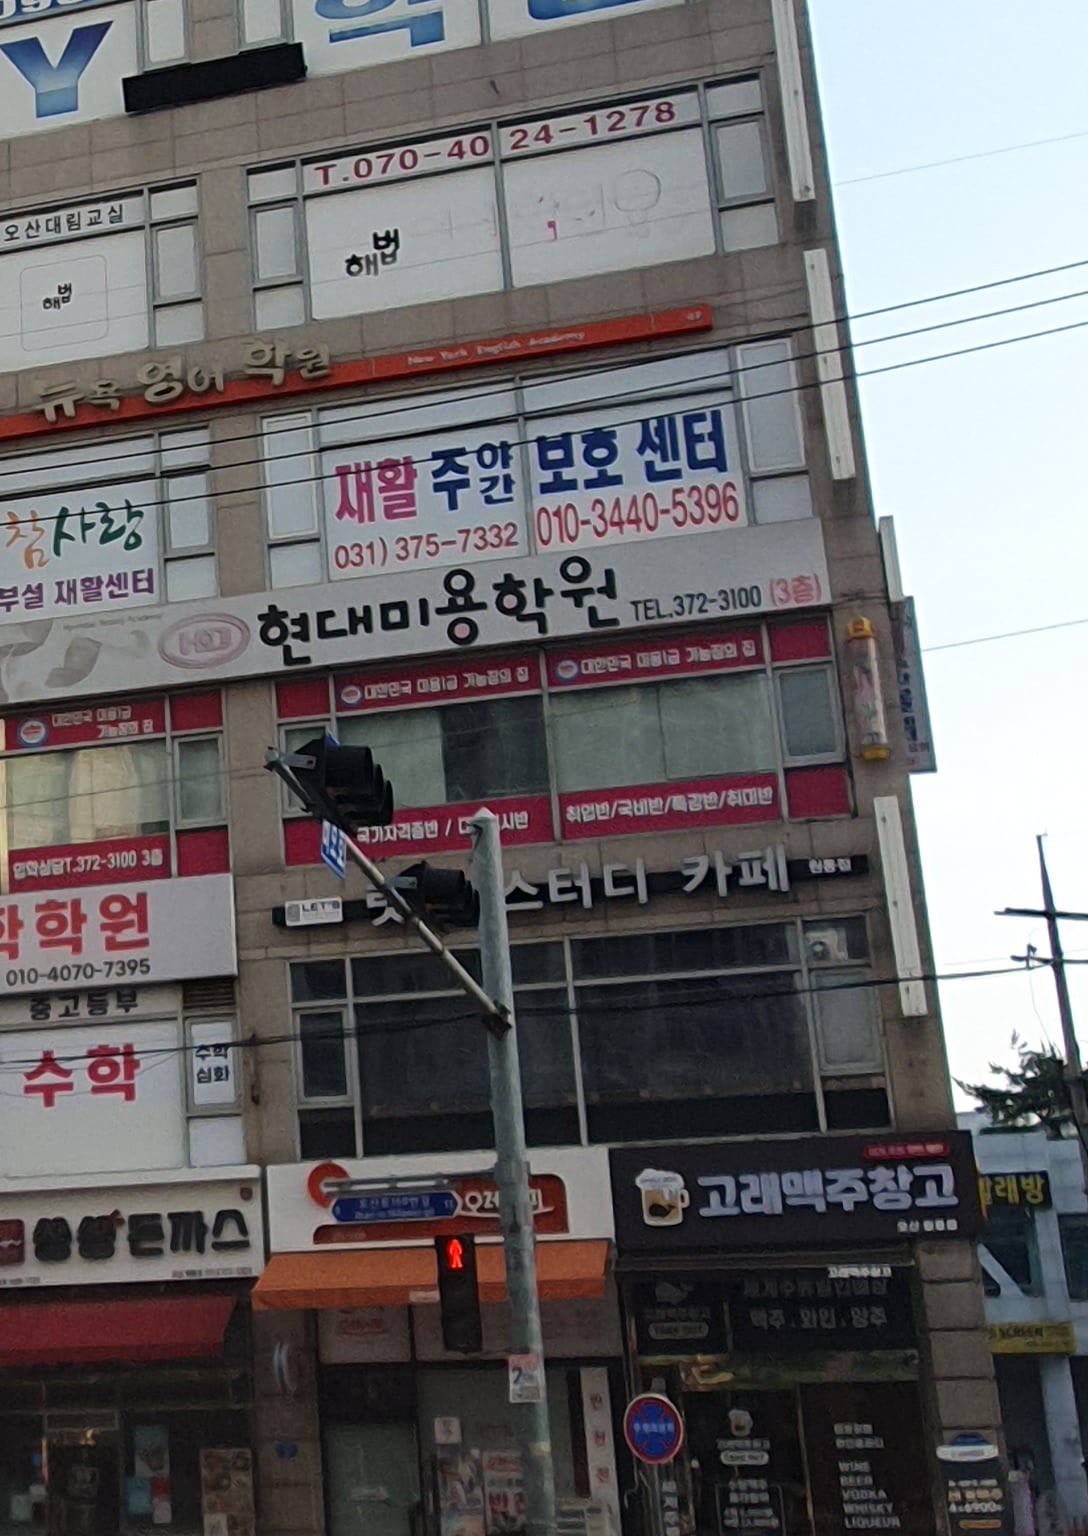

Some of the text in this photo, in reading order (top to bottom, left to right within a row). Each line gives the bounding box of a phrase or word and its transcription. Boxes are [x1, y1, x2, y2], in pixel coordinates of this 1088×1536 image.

[37, 337, 331, 424] 뉴욕 영어 학원
[334, 456, 419, 526] 재활
[535, 427, 624, 497] 보호
[635, 409, 729, 486] 센터
[534, 479, 741, 549] 010-3440-5396
[333, 521, 520, 571] 031) 375-7332
[53, 567, 156, 604] 재활센터
[257, 556, 622, 666] 현대미용학원
[630, 584, 763, 624] TEL.372-3100
[681, 843, 791, 900] 카페
[5, 957, 152, 988] 010-4070-7395
[28, 988, 140, 1022] 중고등부
[22, 1042, 142, 1109] 수학
[696, 1163, 960, 1219] 고래맥주창고
[841, 1488, 887, 1501] VODKA
